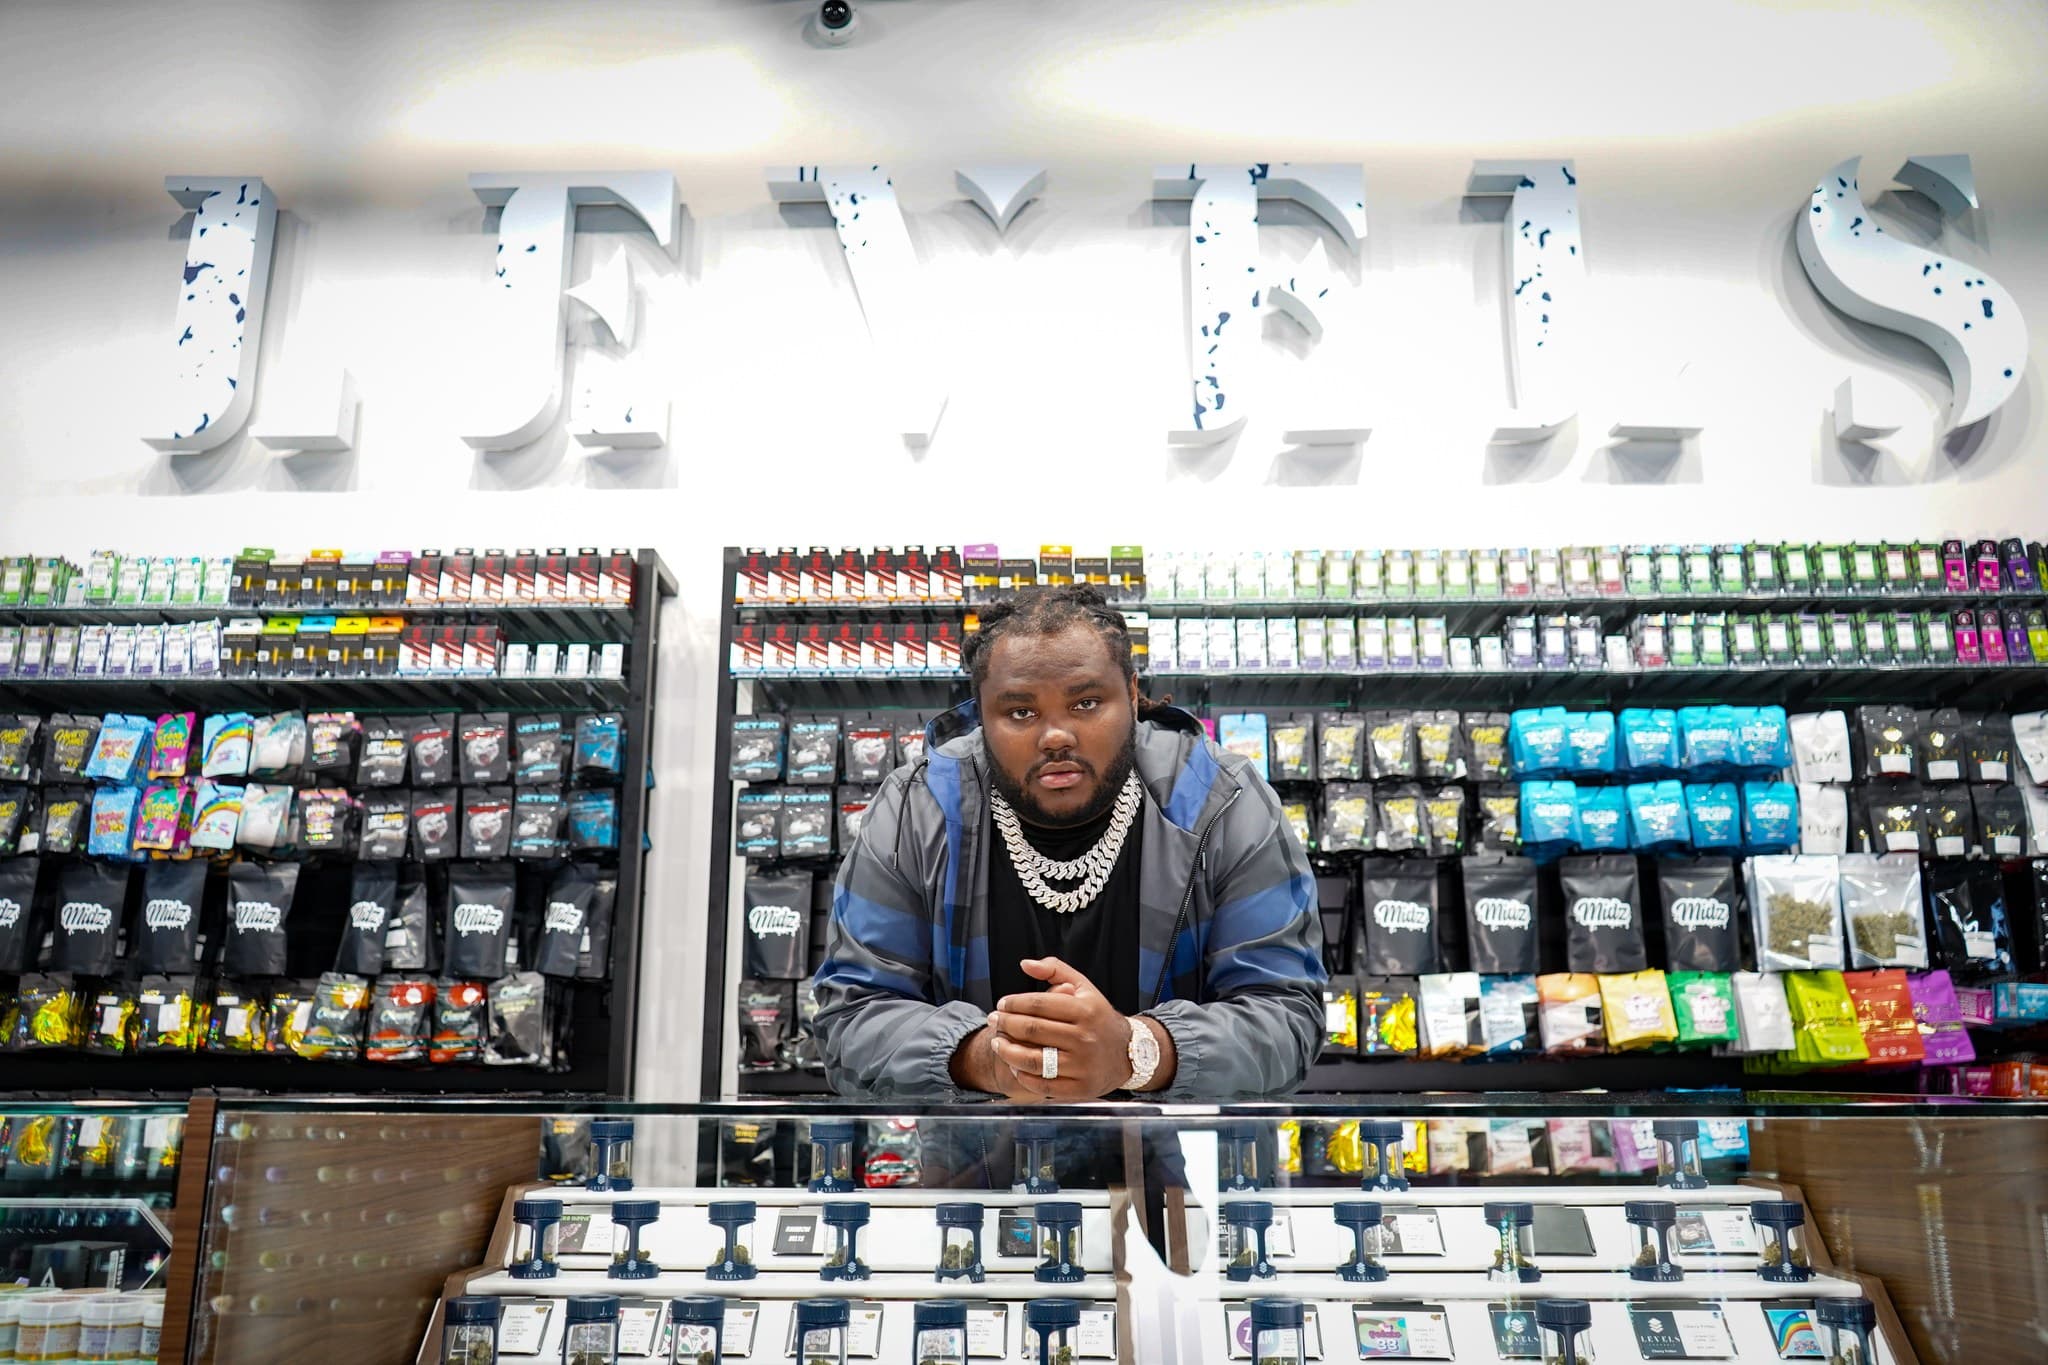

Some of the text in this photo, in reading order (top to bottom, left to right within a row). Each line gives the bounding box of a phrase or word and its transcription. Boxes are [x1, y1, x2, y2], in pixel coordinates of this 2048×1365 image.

[140, 154, 2029, 458] LEVELS
[62, 904, 110, 927] Midz
[147, 901, 190, 923] Midz
[751, 906, 799, 930] Midz
[1376, 903, 1428, 925] Midz
[1478, 901, 1529, 923] Midz
[1576, 900, 1631, 923] Midz
[1674, 900, 1728, 923] Midz
[1501, 1335, 1539, 1343] LEVELS
[1640, 1335, 1681, 1343] LEVELS
